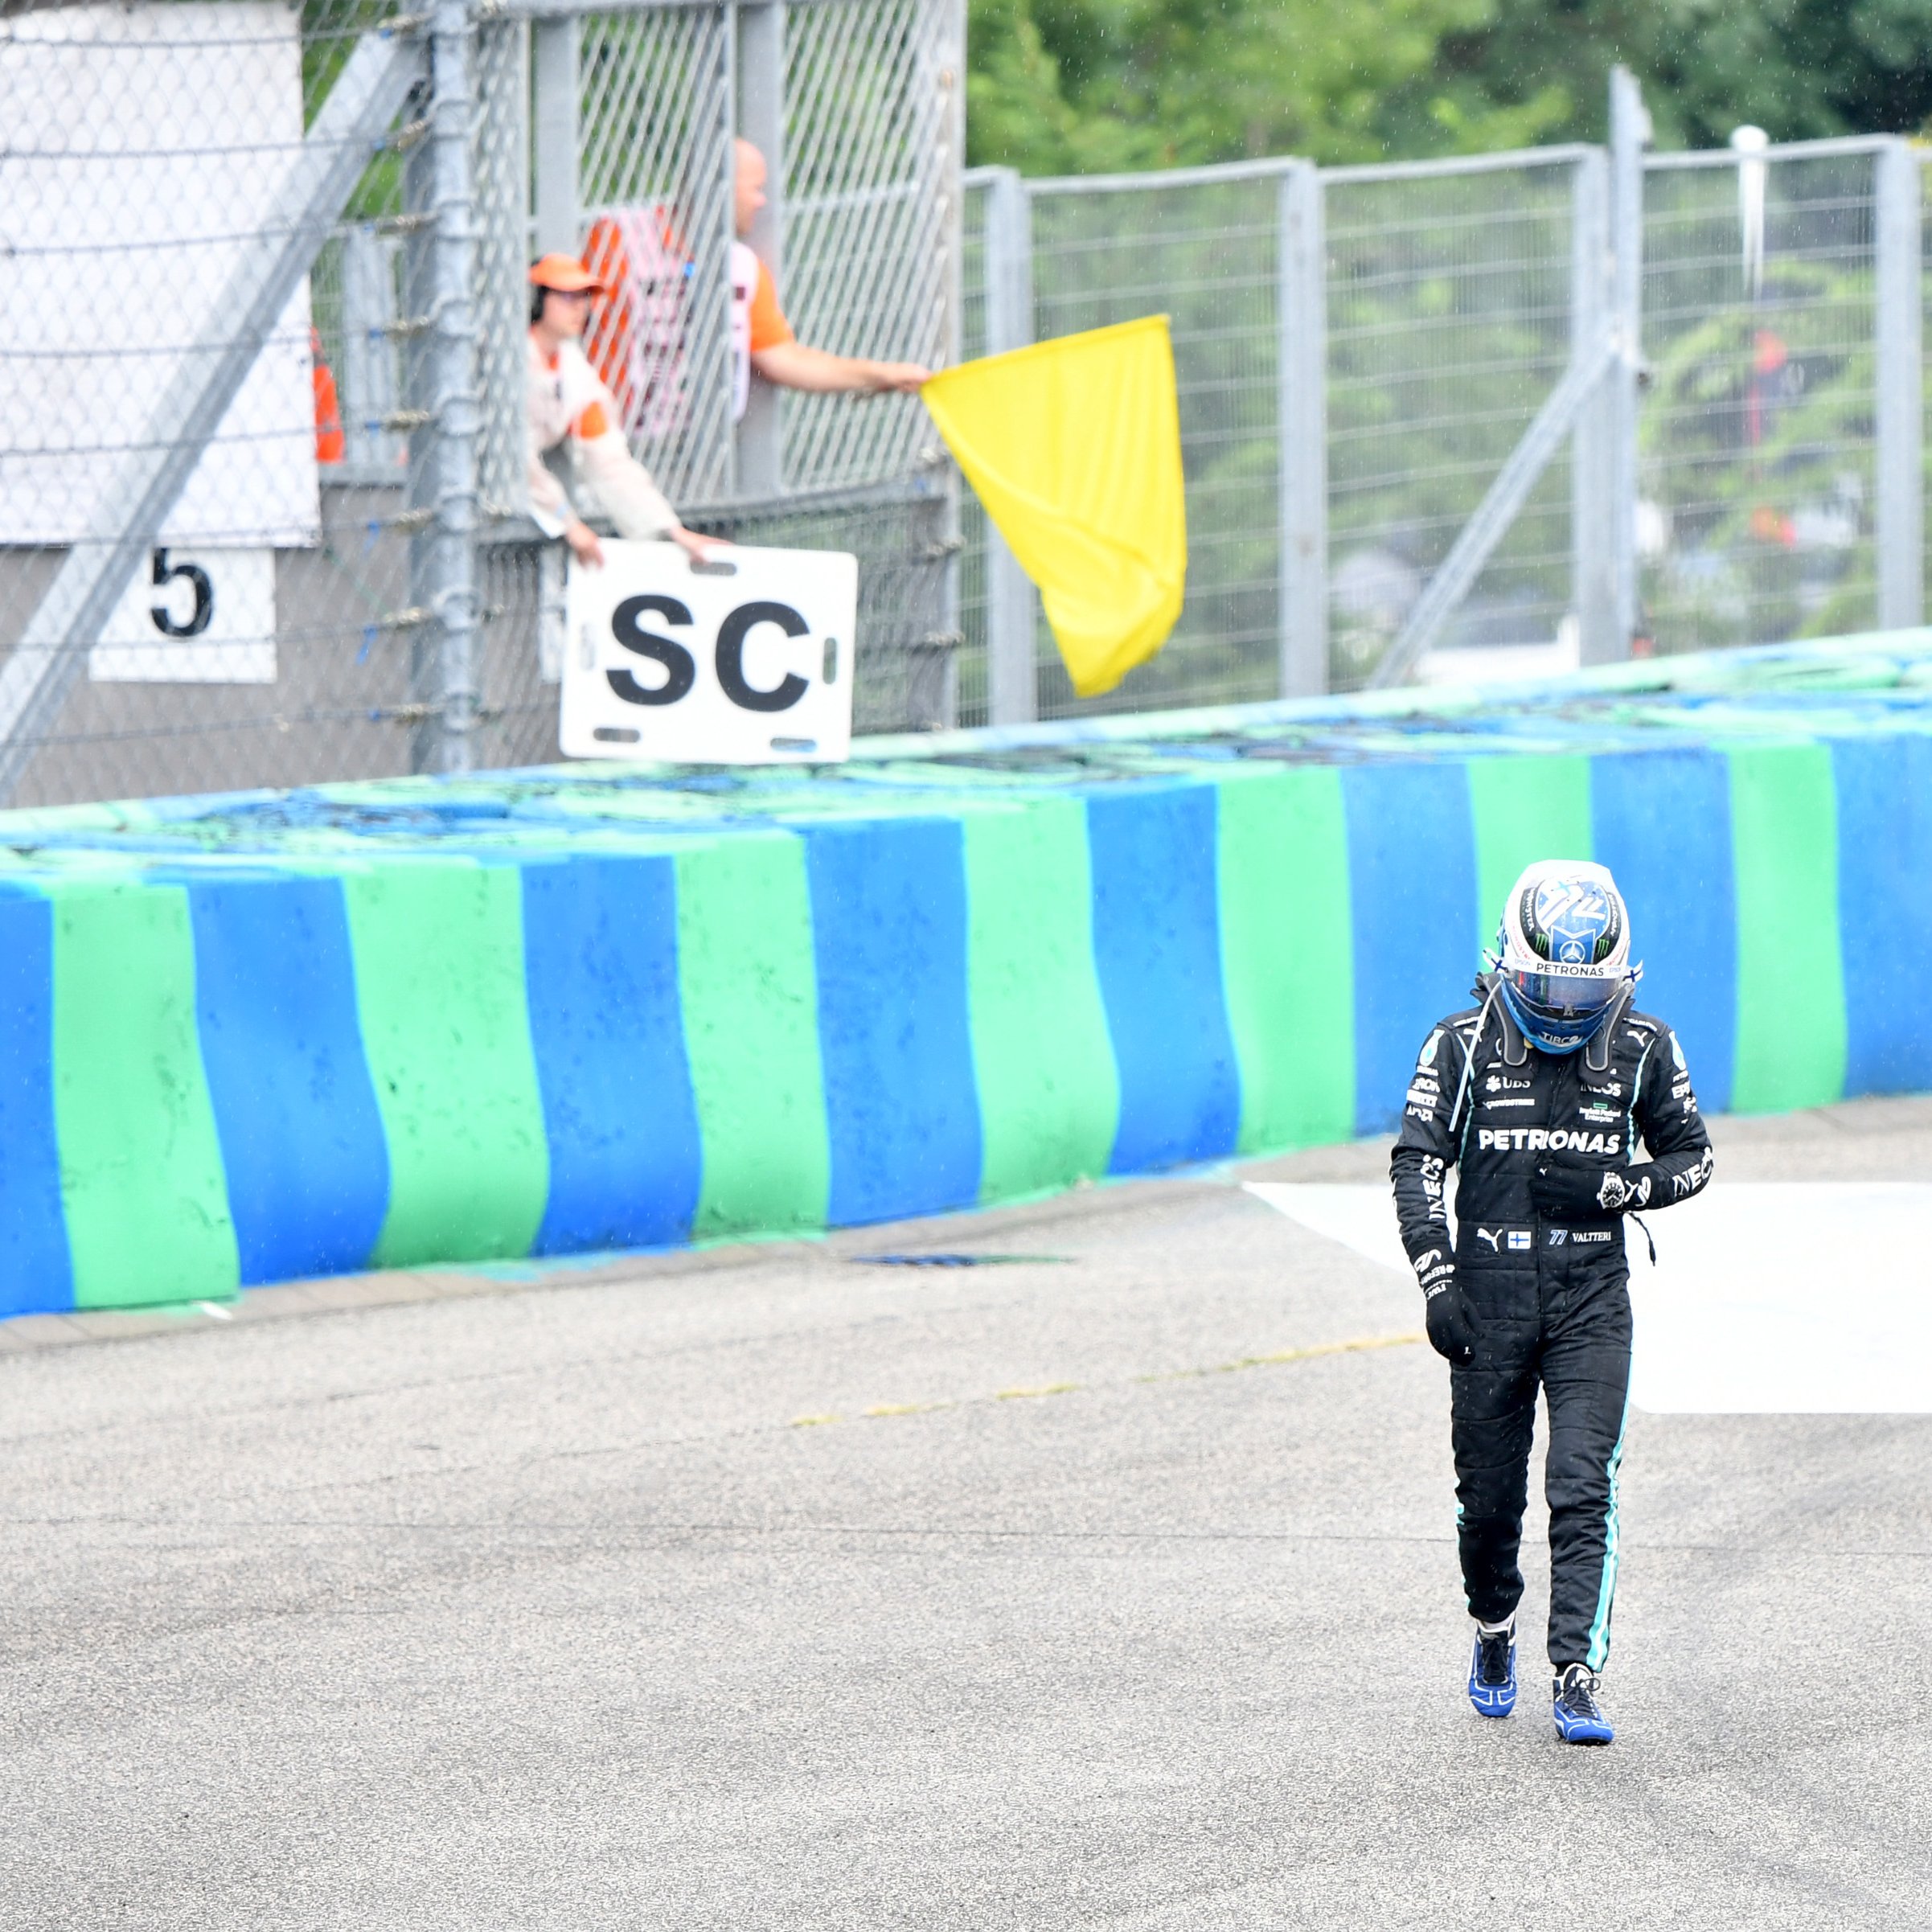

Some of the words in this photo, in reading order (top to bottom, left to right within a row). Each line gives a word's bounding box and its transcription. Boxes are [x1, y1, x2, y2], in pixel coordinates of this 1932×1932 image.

[150, 548, 212, 638] 5
[605, 594, 810, 712] SC
[1536, 962, 1605, 977] PETRONAS
[1479, 1129, 1621, 1155] PETRONAS
[1548, 1229, 1568, 1245] 77
[1572, 1231, 1611, 1243] VALTTERI
